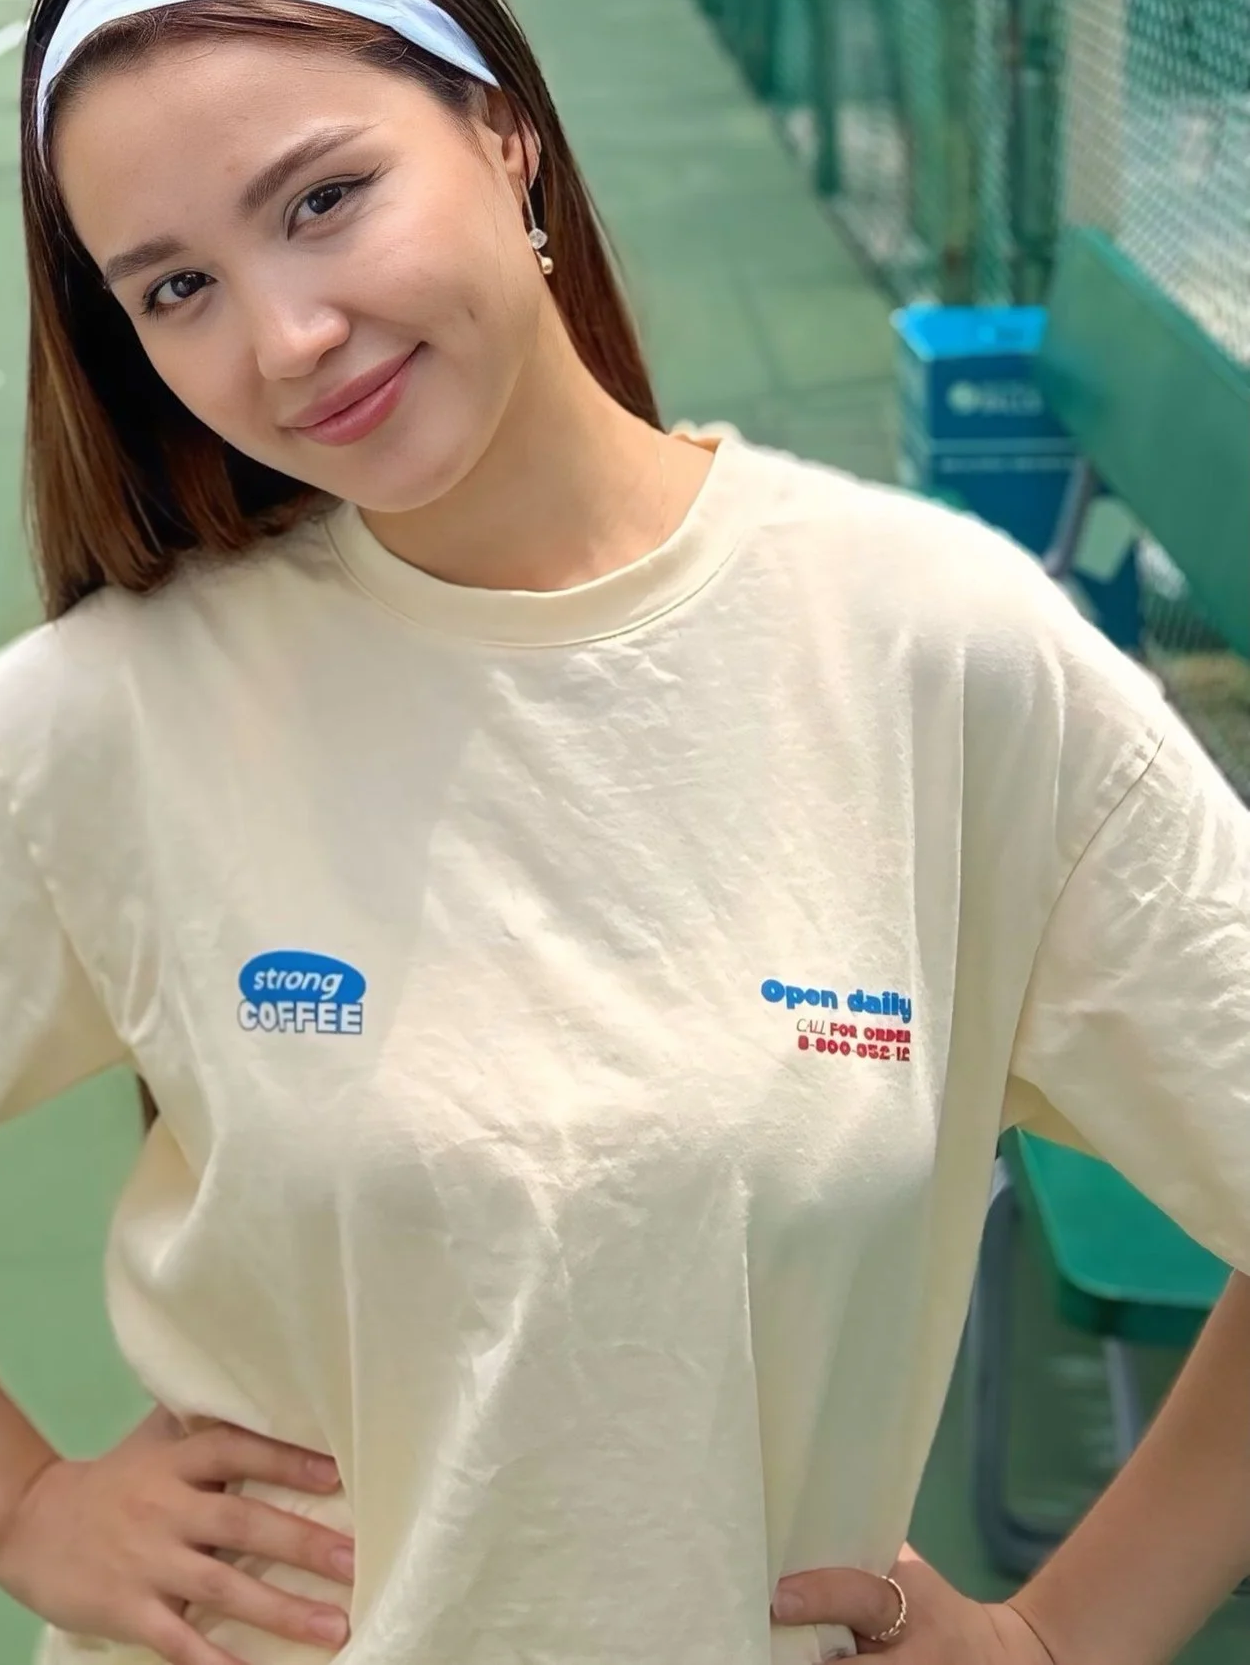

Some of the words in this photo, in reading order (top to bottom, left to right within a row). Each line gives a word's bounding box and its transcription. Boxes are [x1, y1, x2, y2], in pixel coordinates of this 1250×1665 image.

[253, 967, 344, 1001] strong
[760, 978, 839, 1010] Open
[847, 988, 912, 1024] daily
[237, 999, 363, 1035] COFFEE
[796, 1018, 826, 1035] CALL
[829, 1022, 858, 1039] FOR
